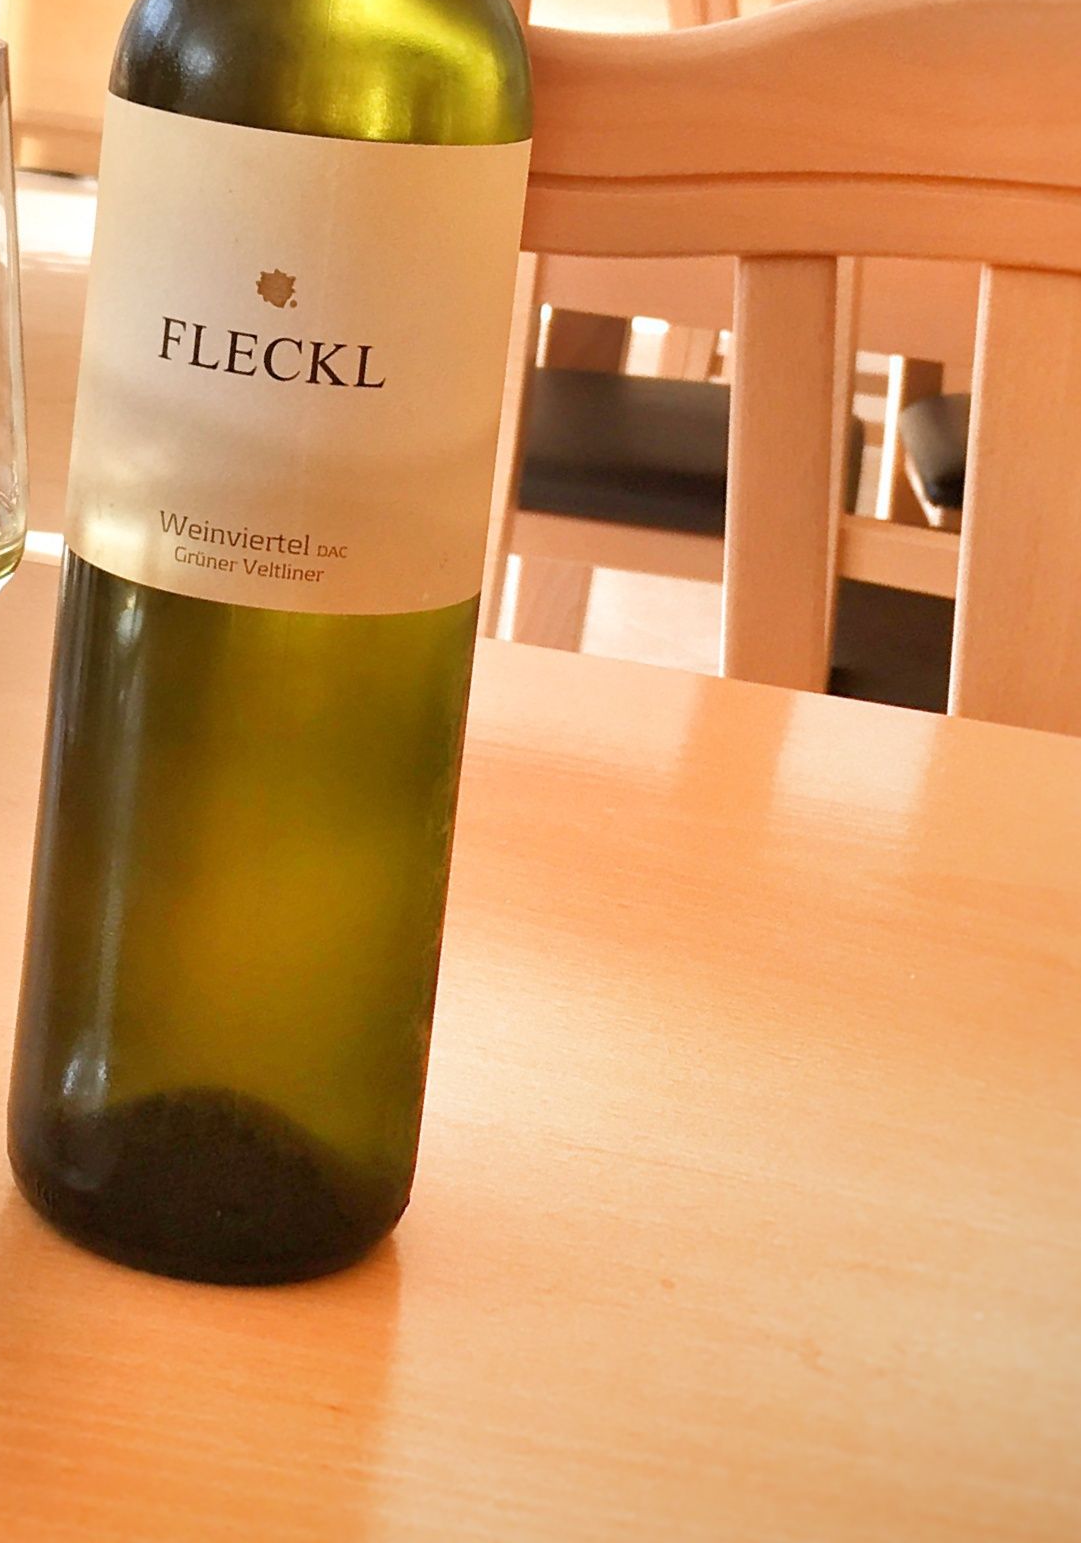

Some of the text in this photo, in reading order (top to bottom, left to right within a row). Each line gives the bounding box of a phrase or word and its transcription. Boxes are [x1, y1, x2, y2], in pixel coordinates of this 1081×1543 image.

[158, 317, 386, 388] FLECKL
[160, 511, 348, 559] Weinviertel DAC
[174, 546, 325, 583] Grüner Veltliner
